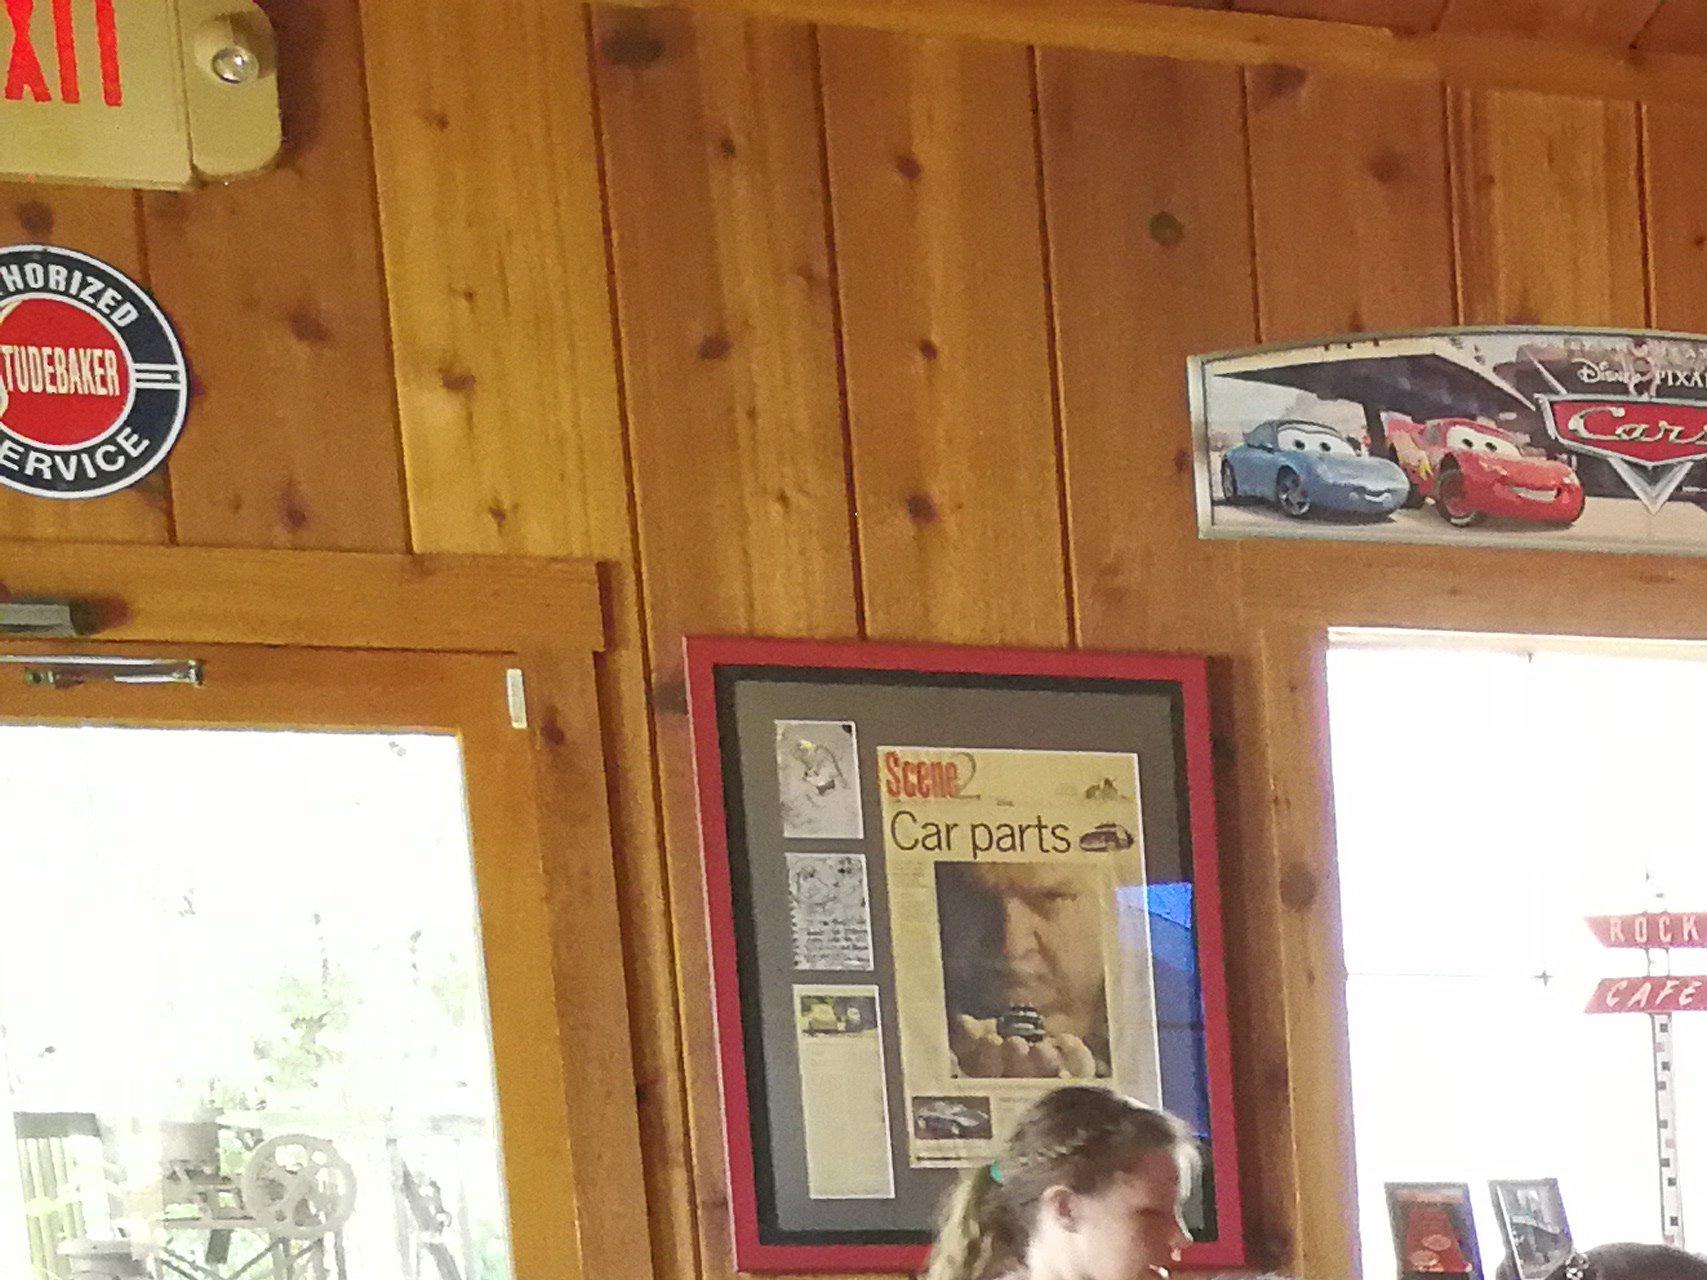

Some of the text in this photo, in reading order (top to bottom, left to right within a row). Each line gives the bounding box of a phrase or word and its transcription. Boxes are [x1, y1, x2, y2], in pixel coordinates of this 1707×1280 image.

[3, 0, 122, 106] XIT
[0, 262, 139, 327] HORIZED
[0, 344, 120, 396] TUDEBAKER
[0, 427, 149, 482] ERVICE
[890, 810, 1071, 860] Car parts
[1610, 915, 1699, 943] ROCK
[1606, 980, 1702, 1007] CAFE
